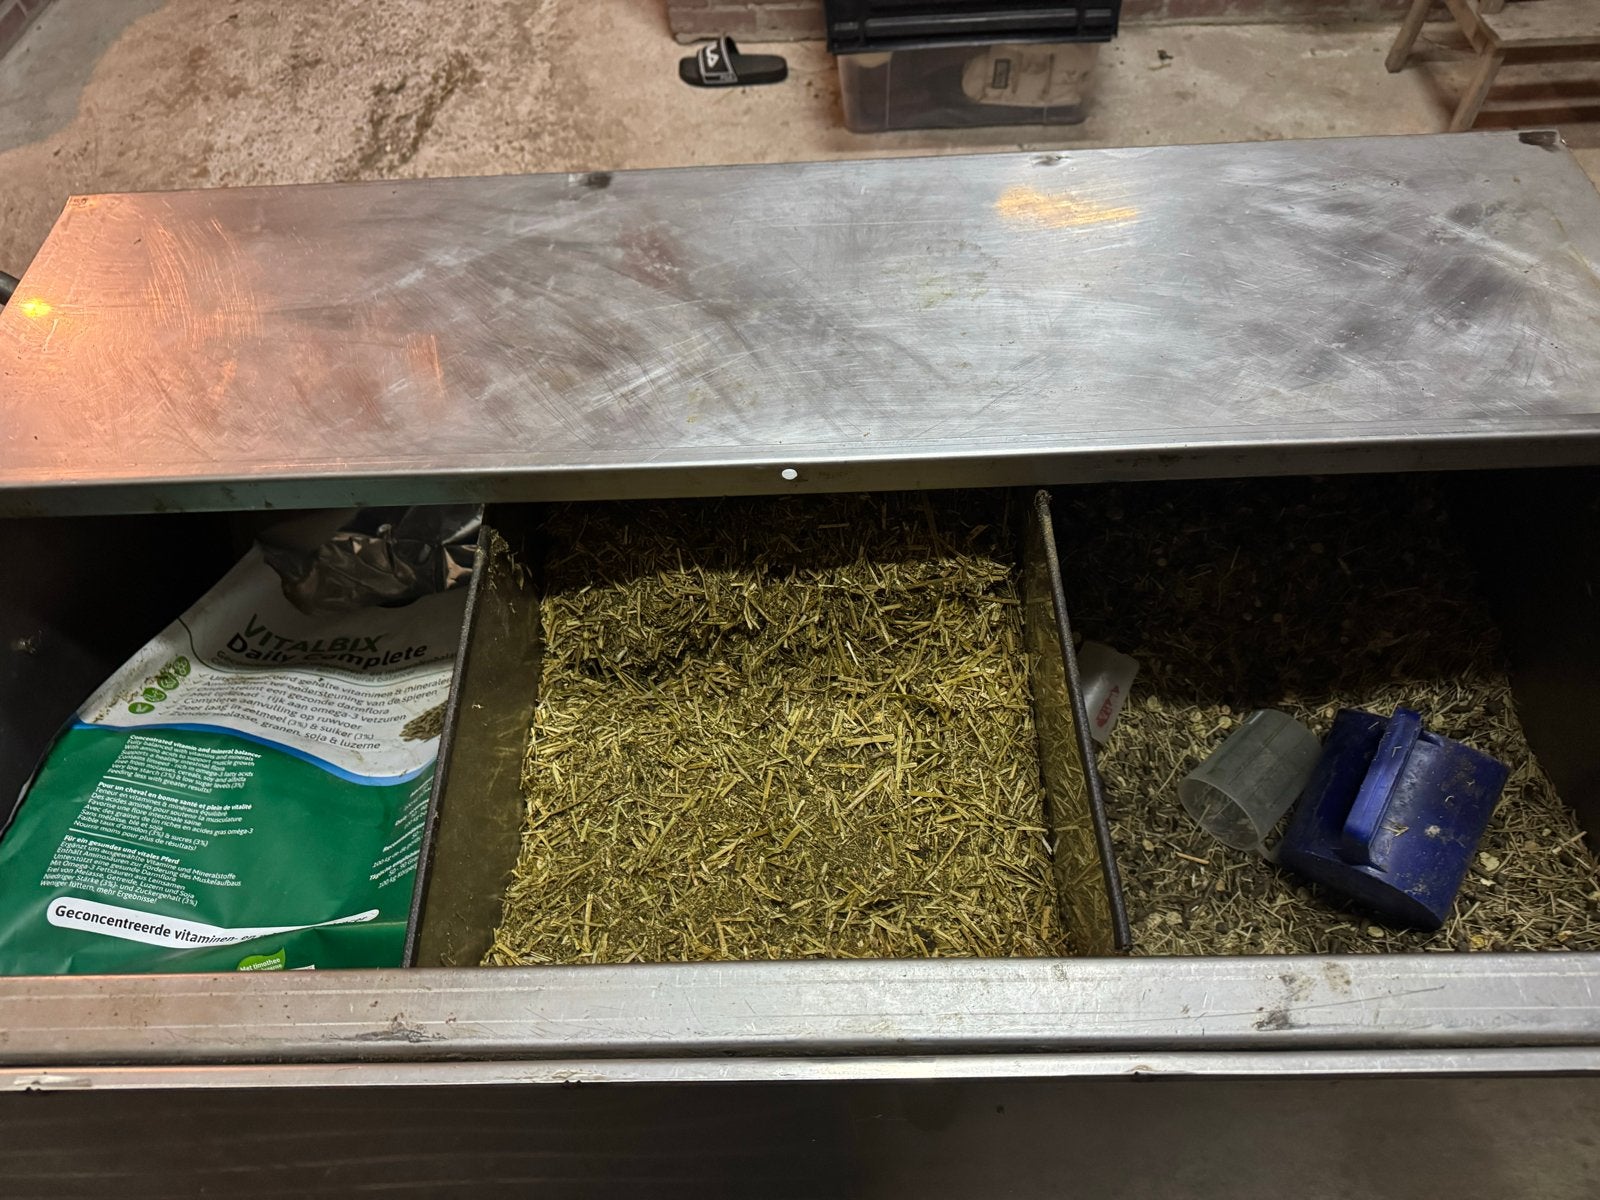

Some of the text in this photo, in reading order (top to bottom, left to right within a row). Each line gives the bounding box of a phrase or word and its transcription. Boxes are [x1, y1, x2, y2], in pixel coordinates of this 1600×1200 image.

[244, 613, 385, 653] VITALBIX
[227, 632, 295, 664] Daily
[266, 687, 286, 696] een
[287, 692, 335, 706] gezonde
[337, 700, 390, 715] darmflora
[287, 684, 364, 706] ondersteuning
[387, 696, 400, 705] de
[401, 689, 438, 704] spieren
[298, 677, 340, 690] gehalte
[341, 687, 393, 699] vitaminen
[240, 698, 298, 718] aanvulling
[300, 713, 315, 722] op
[316, 715, 362, 730] ruwvoer
[243, 707, 288, 723] zetmeel
[309, 723, 318, 731] &
[319, 724, 352, 738] suiker
[267, 695, 286, 705] rijk
[287, 700, 308, 710] aan
[310, 706, 359, 720] omega-3
[361, 713, 407, 724] vetzuren
[129, 734, 174, 746] Concentrated
[173, 741, 197, 751] vitamin
[234, 749, 262, 758] balancer
[260, 721, 301, 737] granen,
[304, 731, 327, 742] soja
[329, 737, 338, 745] &
[340, 739, 381, 749] luzerne
[91, 792, 105, 800] Des
[105, 796, 127, 805] acides
[152, 807, 170, 815] pour
[170, 809, 197, 819] soutenir
[95, 786, 119, 796] Teneur
[129, 794, 161, 805] vitamines
[168, 803, 199, 814] minéraux
[97, 781, 115, 790] Pour
[125, 787, 148, 797] cheval
[157, 793, 179, 803] bonne
[179, 799, 198, 808] santé
[206, 803, 223, 811] plein
[231, 803, 252, 811] vitalité
[80, 808, 98, 818] Sans
[149, 824, 163, 832] soja
[83, 803, 101, 812] Avec
[101, 808, 114, 816] des
[114, 811, 140, 820] graines
[141, 815, 151, 823] de
[160, 820, 181, 829] riches
[191, 826, 214, 836] acides
[213, 829, 227, 837] gras
[88, 798, 117, 809] Favorise
[131, 807, 148, 816] flore
[147, 810, 183, 823] intestinale
[183, 819, 202, 827] saine
[73, 820, 100, 830] Nourrir
[99, 825, 121, 835] moins
[121, 830, 139, 839] pour
[138, 834, 154, 843] plus
[154, 837, 165, 845] de
[77, 814, 99, 824] Faible
[99, 819, 115, 828] taux
[171, 834, 193, 843] sucres
[192, 838, 208, 848] (3%)
[56, 846, 82, 856] Enthält
[82, 851, 130, 866] Aminosäuren
[143, 863, 179, 878] Förderung
[179, 872, 192, 880] des
[60, 841, 87, 851] Ergänzt
[145, 858, 177, 870] Vitamine
[177, 865, 192, 874] und
[191, 868, 236, 880] Mineralstoffe
[63, 834, 76, 842] Für
[88, 840, 122, 851] gesundes
[137, 850, 160, 860] vitales
[160, 855, 180, 865] Pferd
[53, 853, 177, 882] Unterstützt eine gesunde Darmflora
[62, 860, 96, 871] Omega-3
[95, 865, 133, 877] Fettsäuren
[133, 873, 147, 881] aus
[147, 877, 186, 890] Leinsamen
[40, 879, 69, 887] Weniger
[96, 886, 117, 896] mehr
[116, 890, 157, 904] Ergebnisse!
[42, 873, 76, 881] Niedriger
[75, 875, 100, 885] Stärke
[119, 883, 134, 892] und
[134, 886, 181, 903] Zuckergehalt
[181, 897, 198, 907] (3%)
[139, 879, 164, 891] Luzern
[164, 886, 179, 895] und
[179, 890, 195, 899] Soja
[55, 904, 171, 938] Geconcentreerde
[174, 927, 239, 944] vitaminen-
